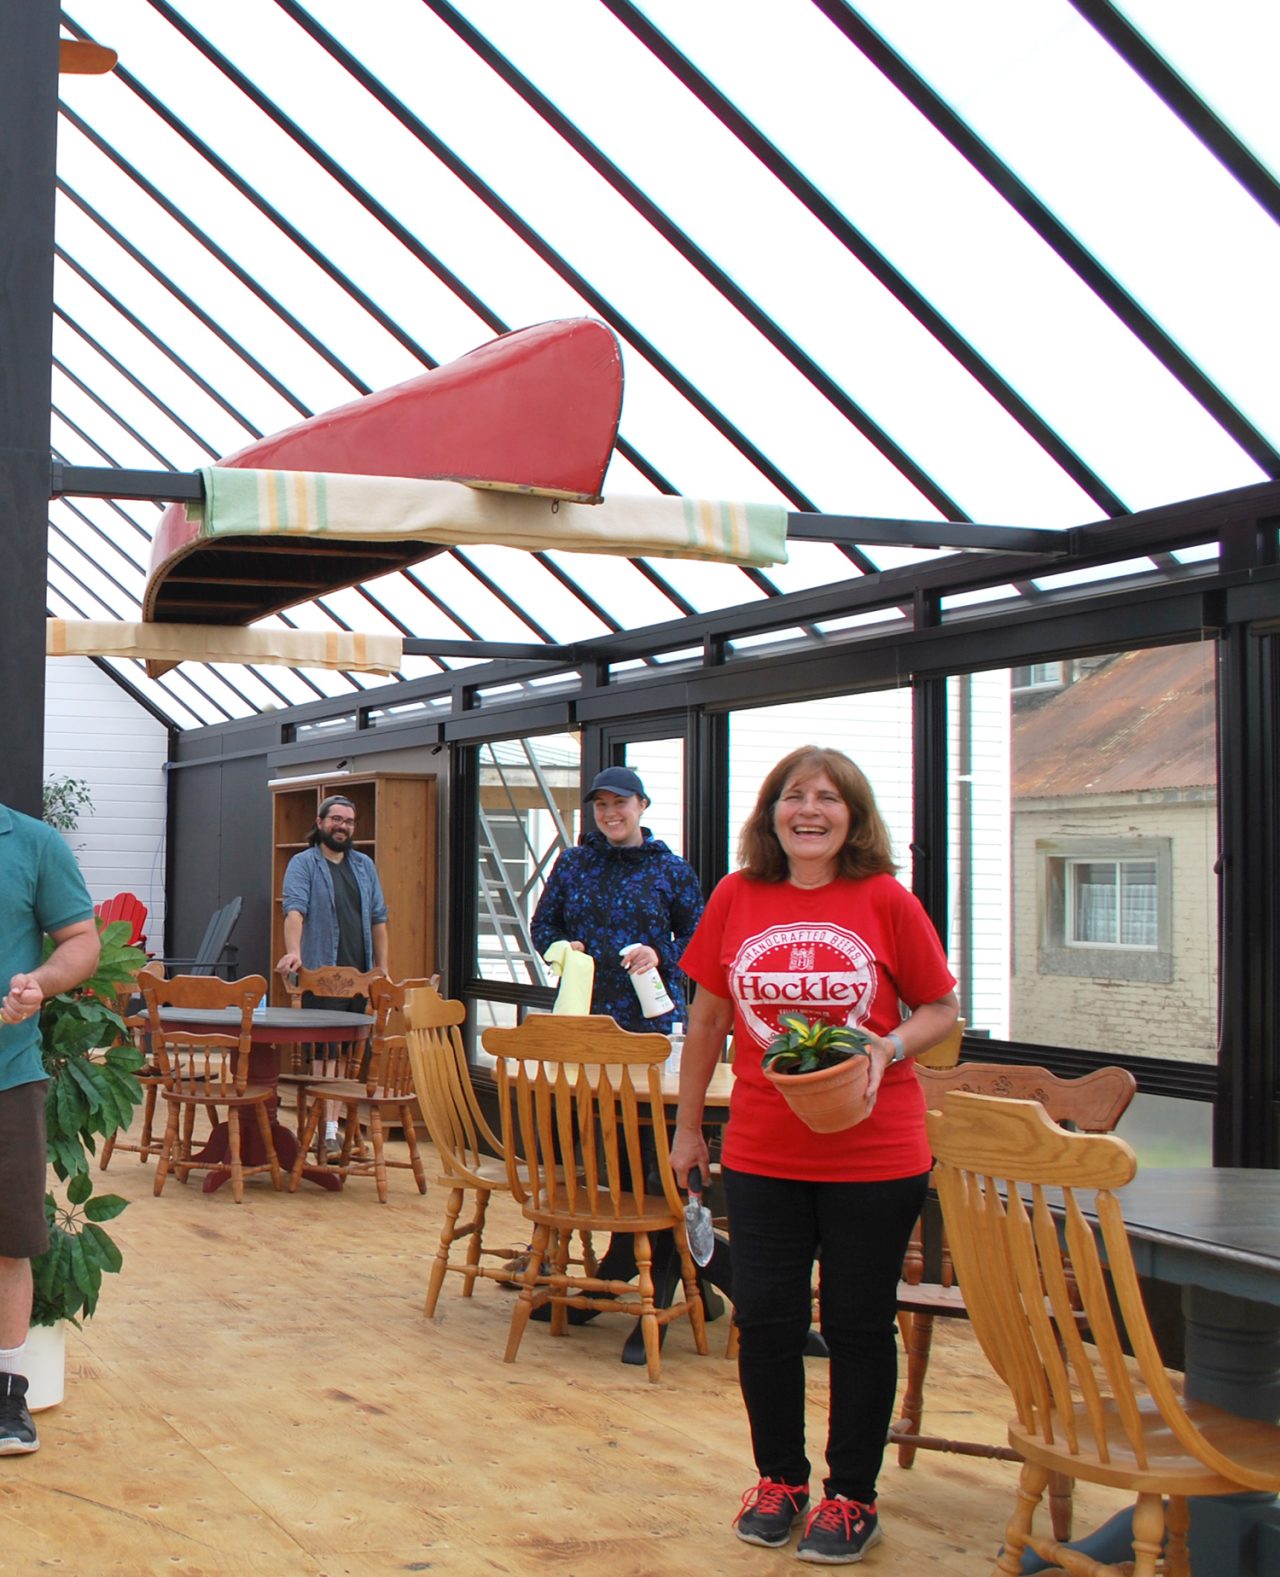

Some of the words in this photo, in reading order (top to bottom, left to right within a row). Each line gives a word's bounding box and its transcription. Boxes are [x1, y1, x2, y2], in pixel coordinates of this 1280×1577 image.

[745, 931, 827, 961] HANDCRAFTED
[830, 935, 862, 961] BEERS
[737, 976, 868, 1003] Hockley
